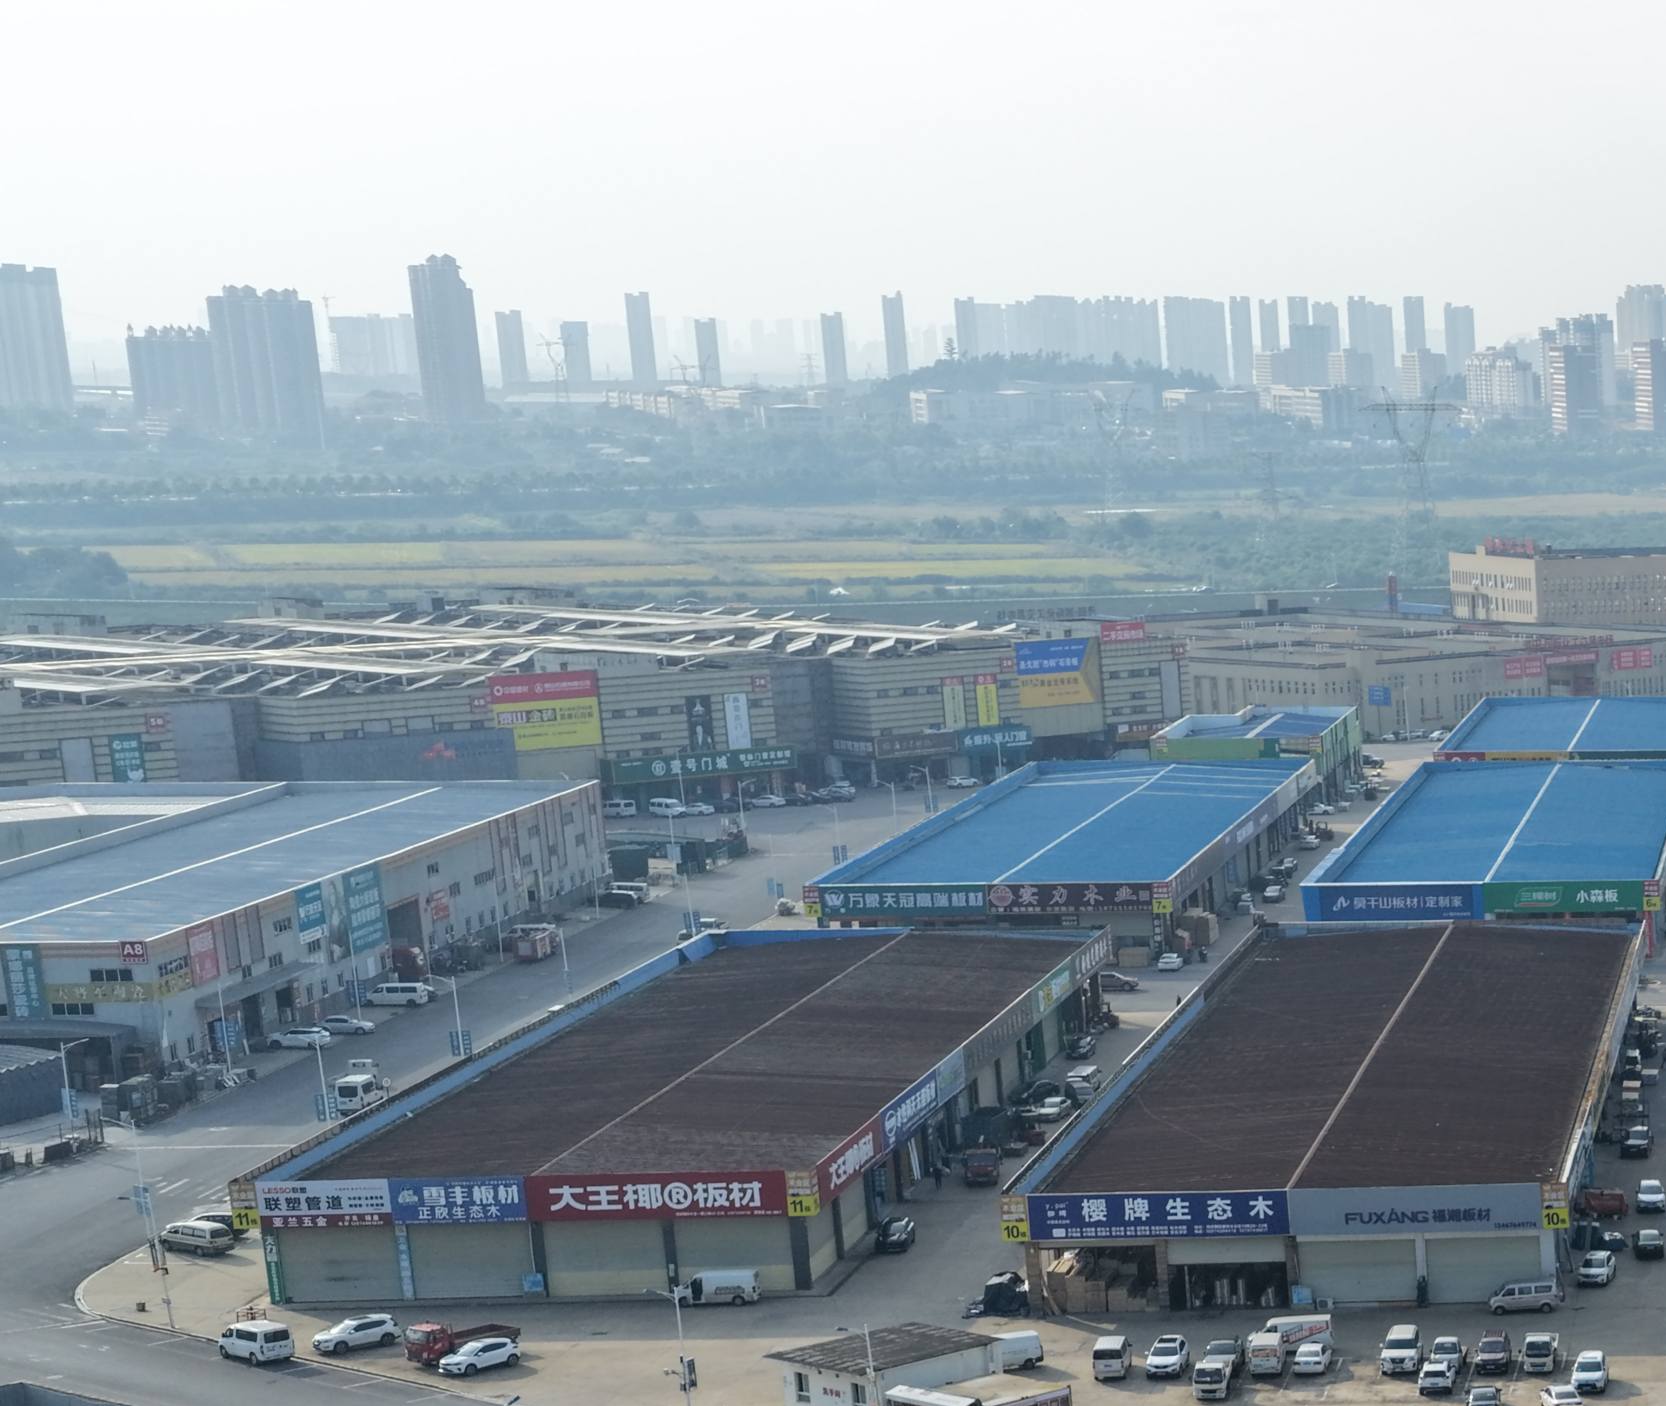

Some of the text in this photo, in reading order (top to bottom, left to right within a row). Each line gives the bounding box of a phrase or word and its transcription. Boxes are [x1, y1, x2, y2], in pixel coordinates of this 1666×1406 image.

[1018, 884, 1138, 906] 实力木业
[1575, 889, 1619, 904] 小森板
[123, 943, 143, 955] A8
[265, 1195, 345, 1212] 联塑管道
[423, 1185, 520, 1206] 雪丰板材
[417, 1205, 502, 1220] 正欣生态木
[1081, 1195, 1275, 1223] 樱牌生态木
[1432, 1207, 1492, 1223] 福湘板材
[272, 1216, 330, 1228] 亚兰五金
